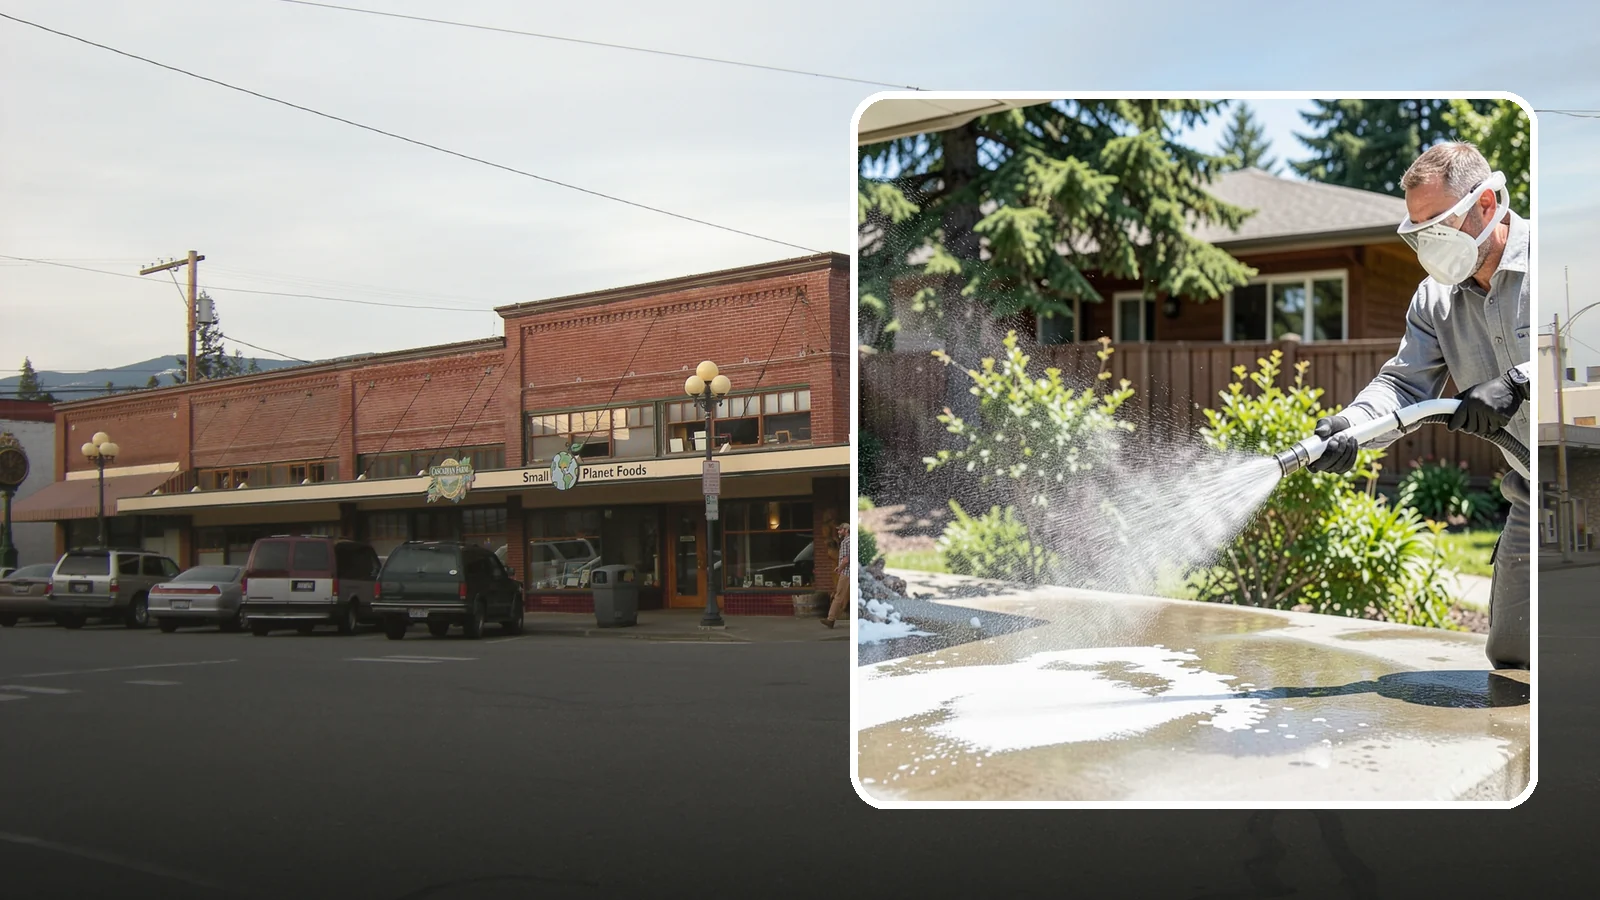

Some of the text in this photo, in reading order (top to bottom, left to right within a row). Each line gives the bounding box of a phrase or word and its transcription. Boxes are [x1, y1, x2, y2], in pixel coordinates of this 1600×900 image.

[523, 465, 647, 483] Small Planet Foods
